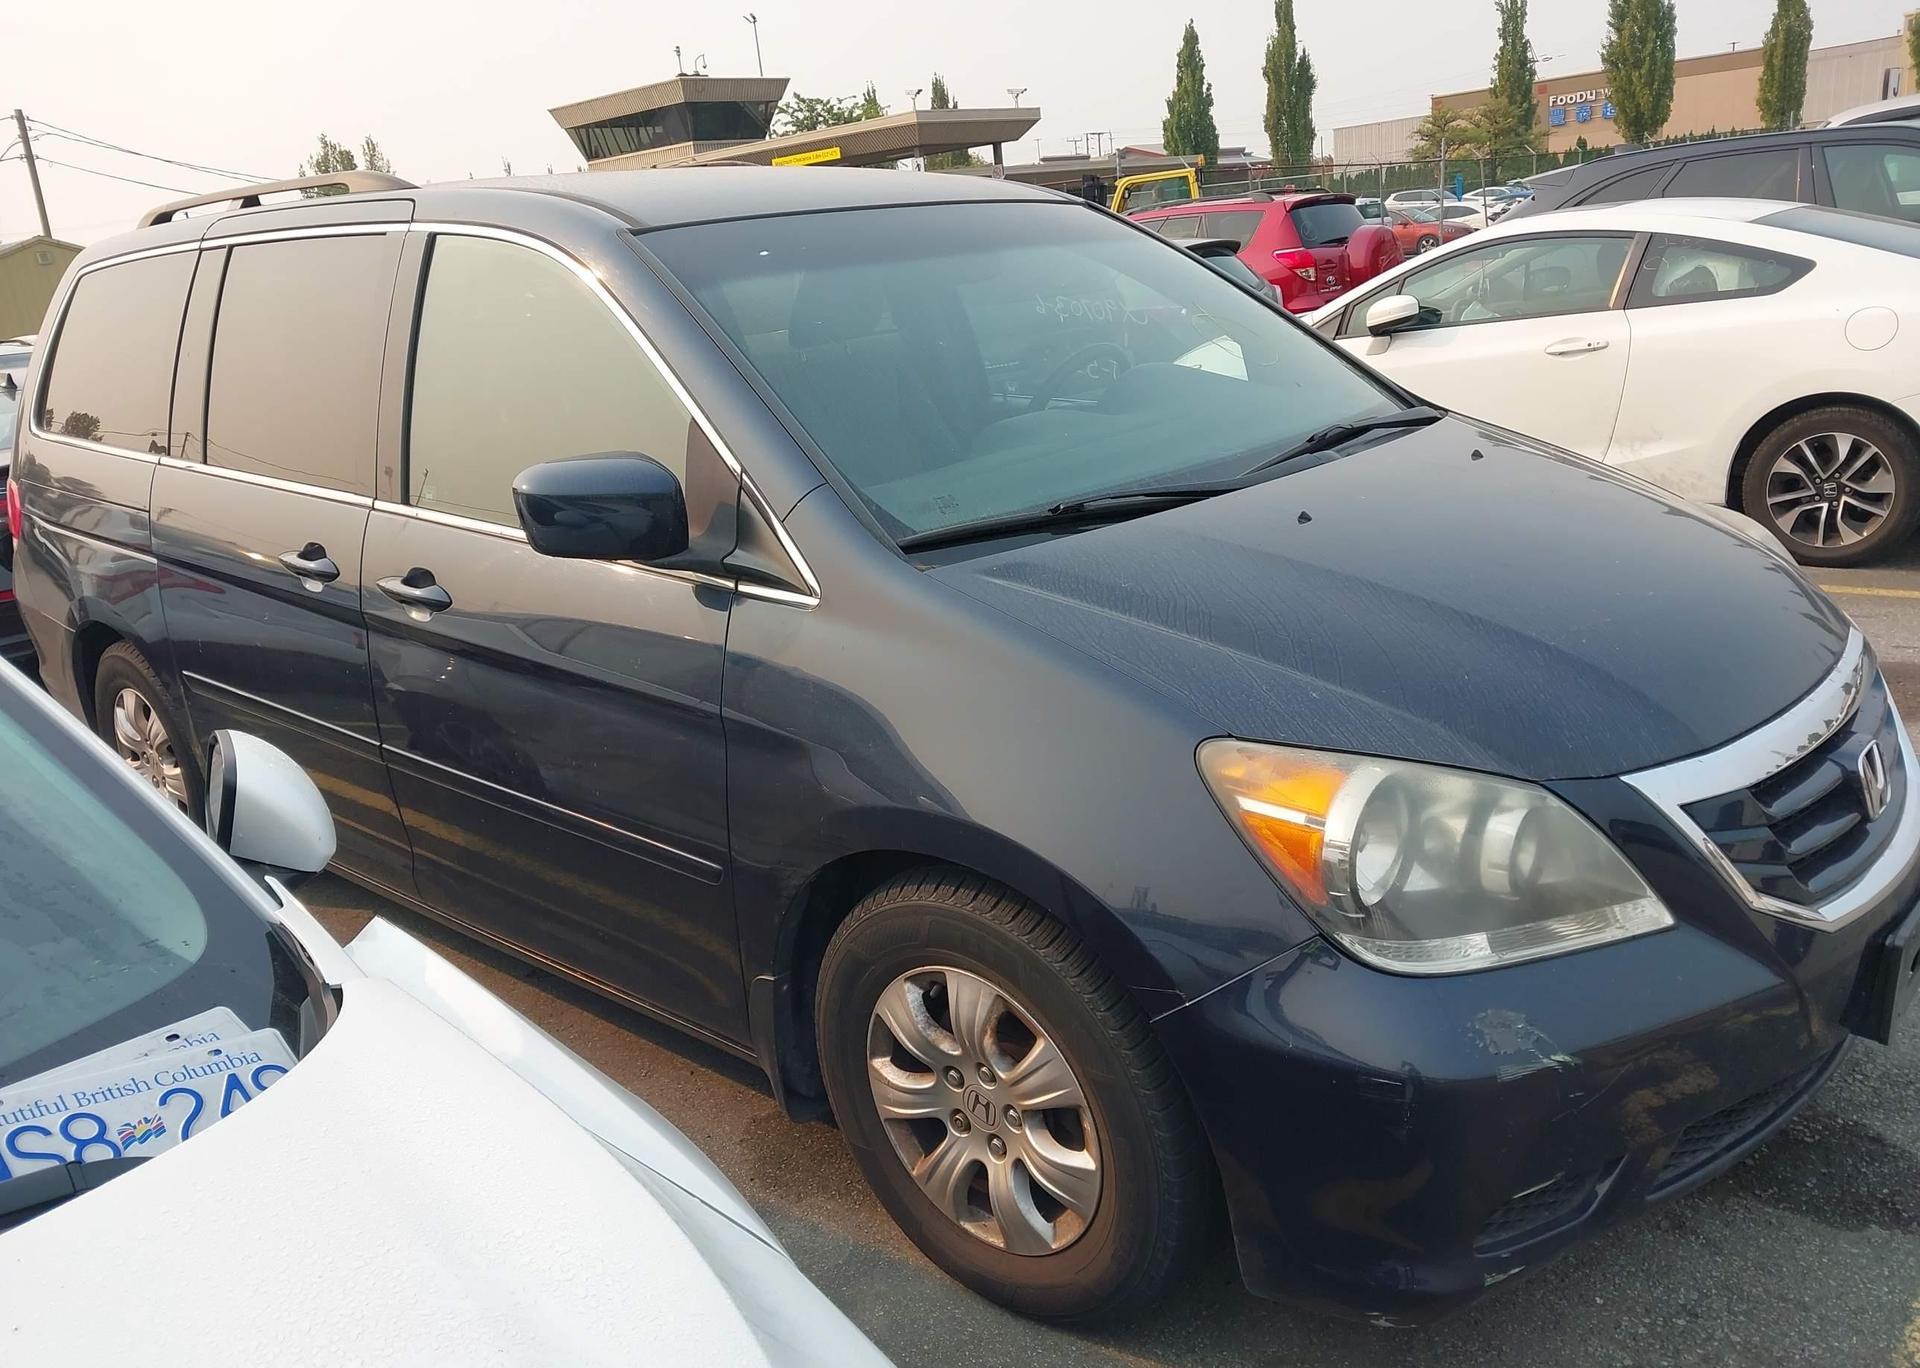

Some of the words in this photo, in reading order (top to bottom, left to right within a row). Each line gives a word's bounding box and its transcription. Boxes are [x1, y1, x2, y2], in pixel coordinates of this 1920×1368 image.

[0, 1095, 69, 1127] utiful
[72, 1076, 152, 1109] British
[154, 1050, 263, 1086] Columbia
